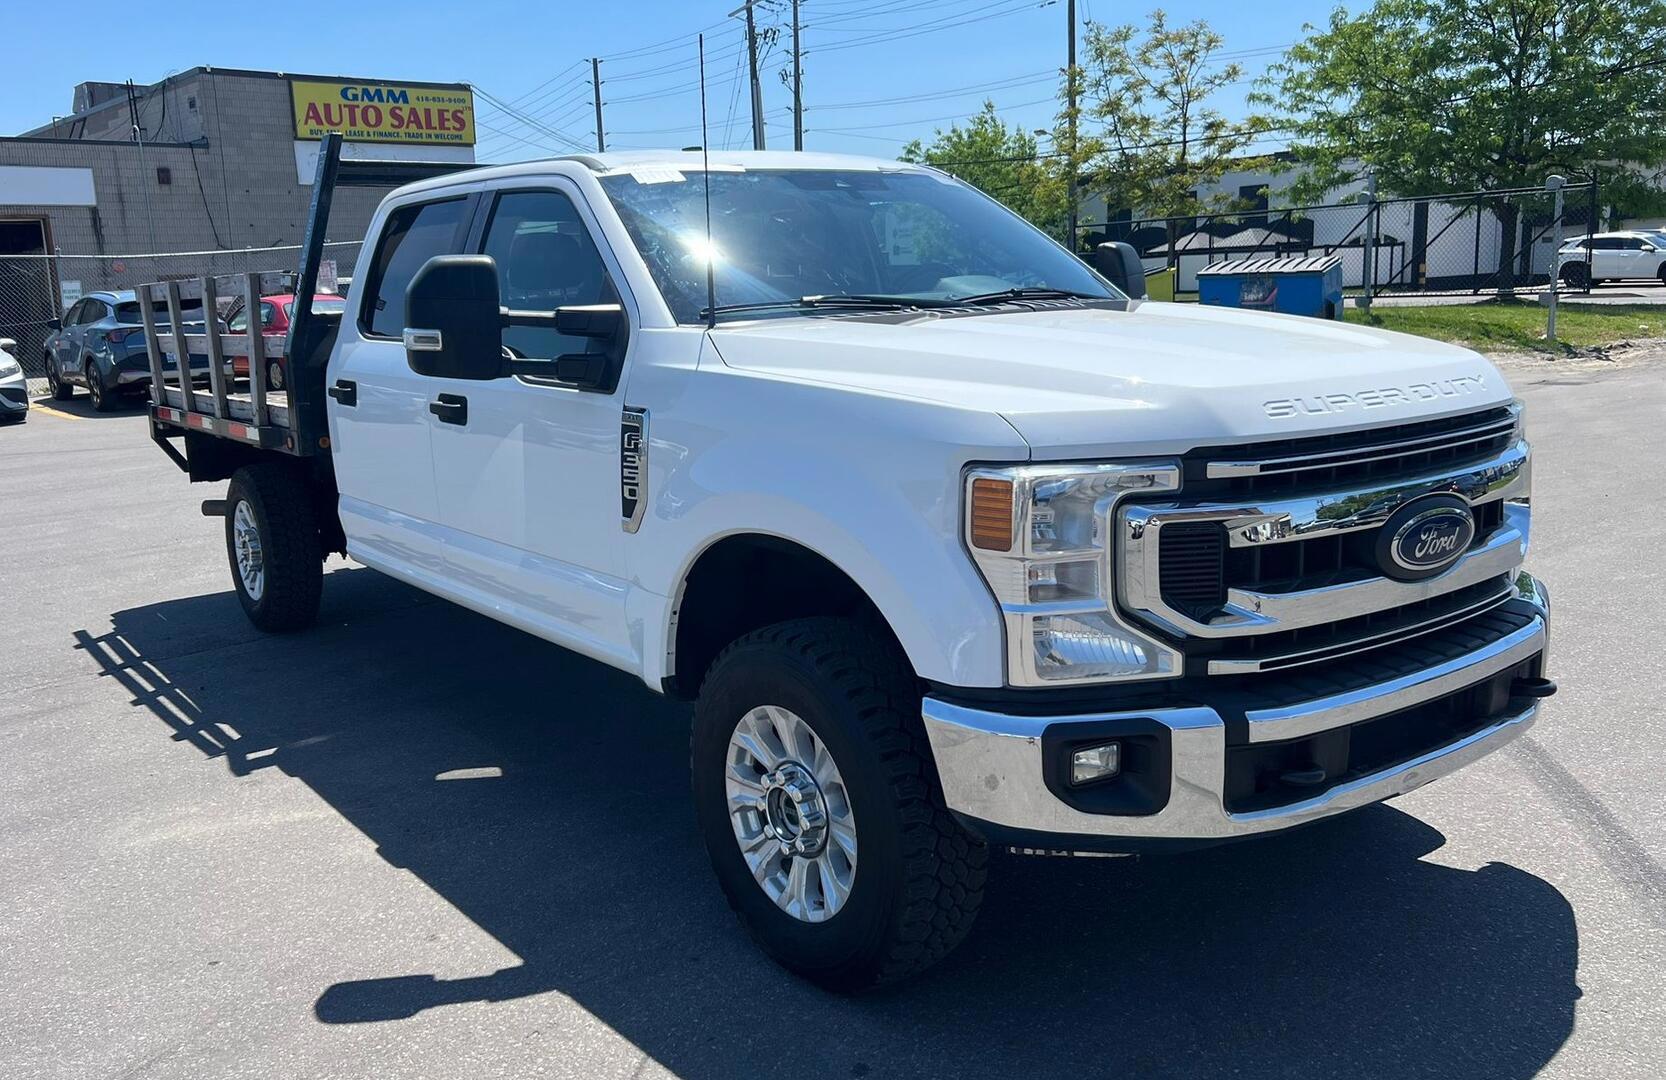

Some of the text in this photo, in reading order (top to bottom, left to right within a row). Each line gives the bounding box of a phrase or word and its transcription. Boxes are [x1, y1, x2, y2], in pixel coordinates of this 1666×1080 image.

[340, 86, 409, 104] GMM
[304, 102, 383, 128] AUTO
[390, 107, 466, 132] SALES
[1263, 374, 1489, 420] SUPER DUTY
[1415, 521, 1460, 558] Ford
